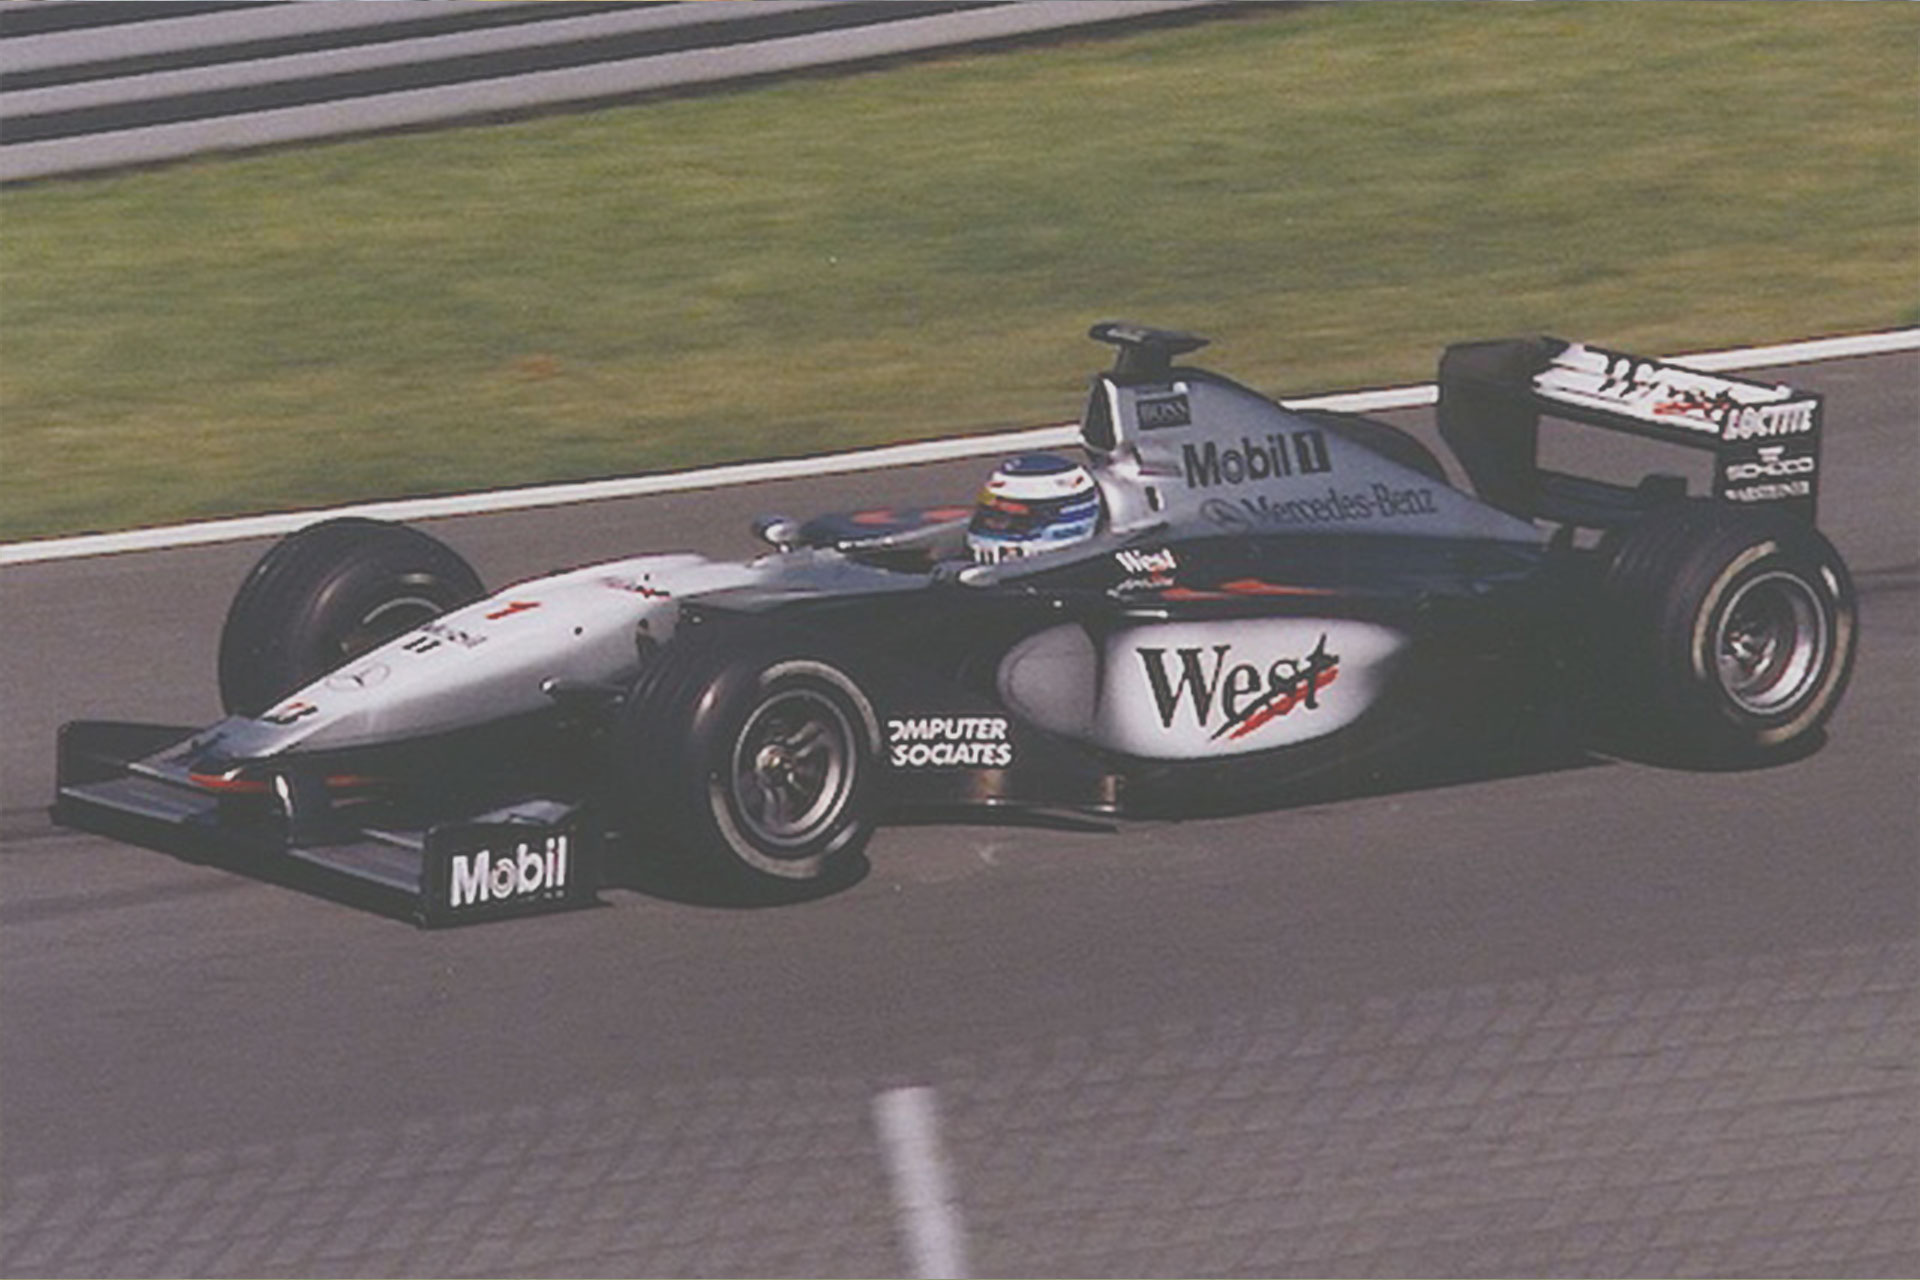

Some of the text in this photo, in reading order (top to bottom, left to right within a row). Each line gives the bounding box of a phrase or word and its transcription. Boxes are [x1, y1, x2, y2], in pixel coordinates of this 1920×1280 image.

[1722, 400, 1817, 440] LOCTITE
[1183, 432, 1292, 488] Mobil
[1241, 484, 1438, 524] Mercedes-Benz
[1136, 632, 1339, 738] West
[450, 835, 567, 907] Mobil
